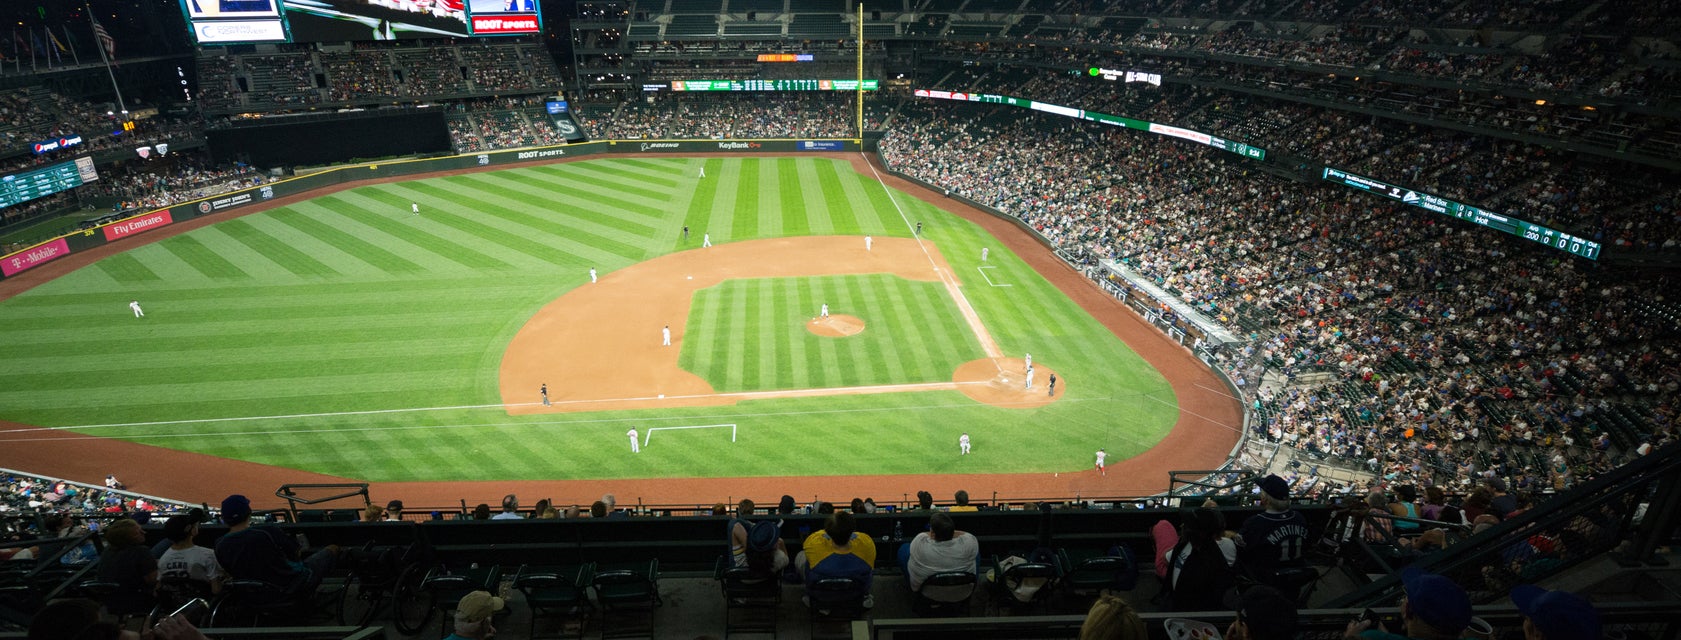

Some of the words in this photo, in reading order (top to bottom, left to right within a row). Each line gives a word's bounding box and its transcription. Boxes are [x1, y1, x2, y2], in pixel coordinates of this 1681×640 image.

[475, 20, 502, 29] ROOT
[519, 151, 538, 159] ROOT
[1426, 195, 1438, 204] Red
[1438, 198, 1448, 207] Sox
[1424, 202, 1446, 213] Mariners
[113, 224, 129, 235] Fly
[129, 215, 163, 230] Emirates
[1475, 216, 1488, 225] Holt
[1559, 239, 1567, 249] 0
[1572, 243, 1580, 253] 0
[1587, 248, 1593, 257] 1
[1280, 537, 1302, 561] 11
